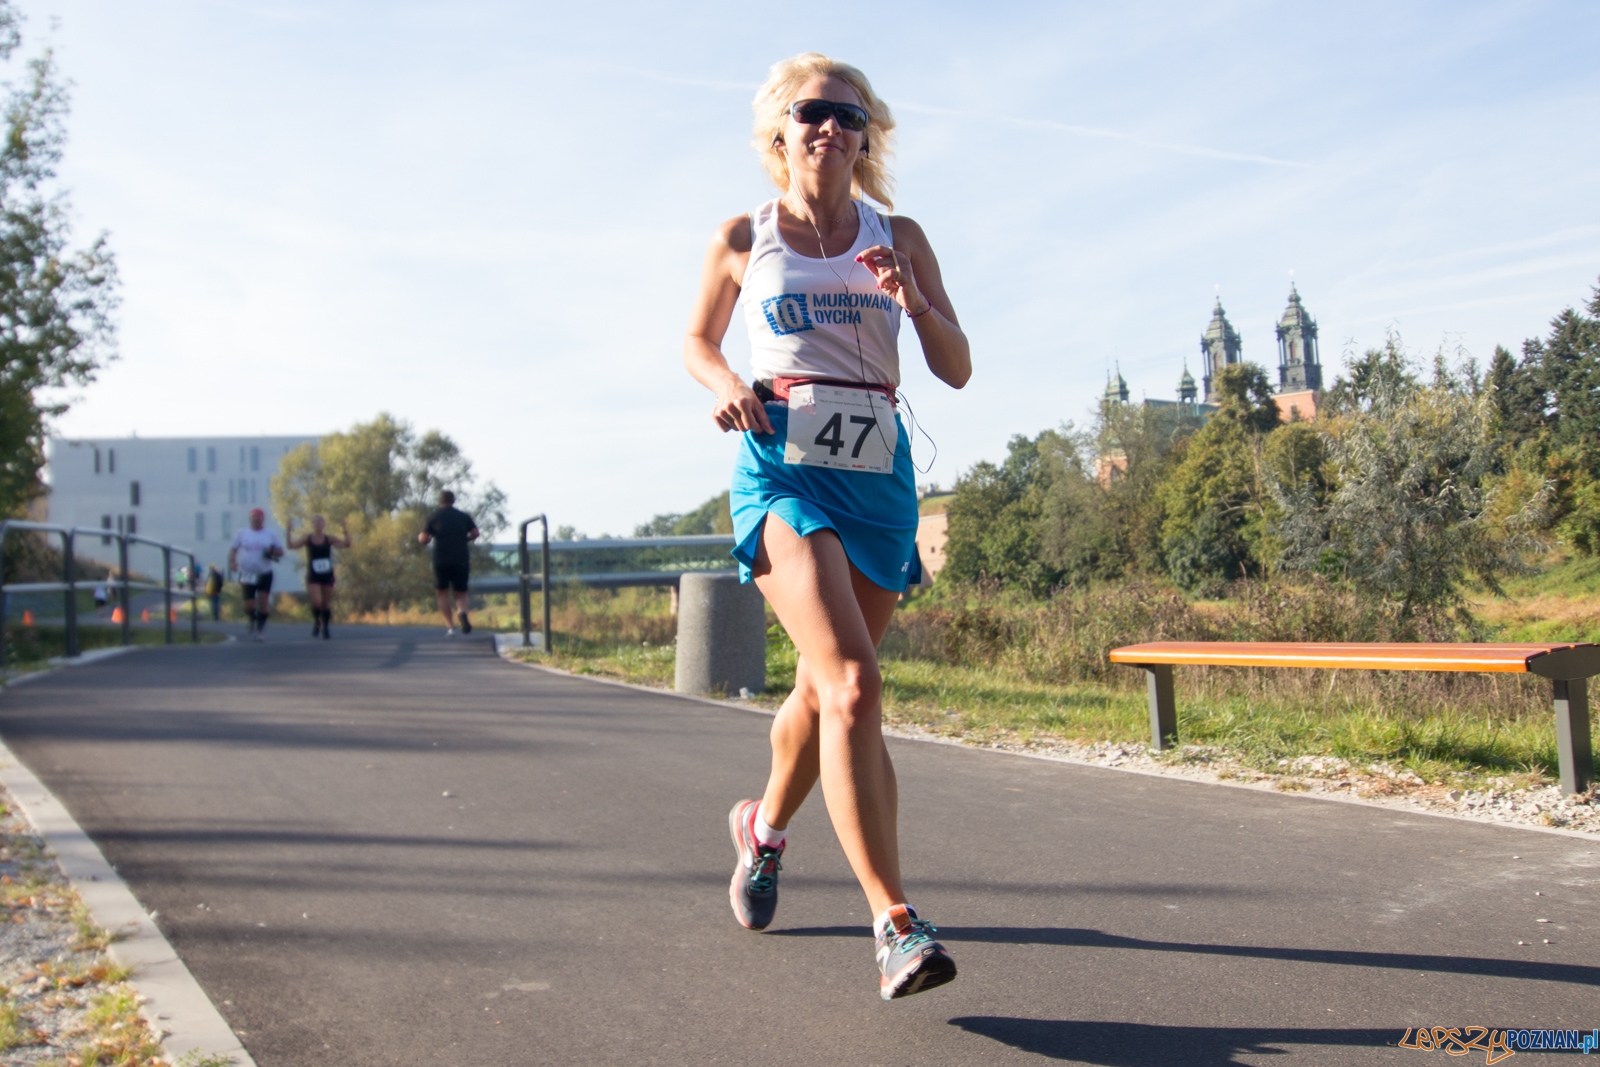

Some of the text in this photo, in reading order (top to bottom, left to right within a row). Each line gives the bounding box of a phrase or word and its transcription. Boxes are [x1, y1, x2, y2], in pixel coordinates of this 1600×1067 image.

[763, 296, 806, 335] 10
[812, 293, 892, 312] MUROWANA
[815, 310, 861, 325] DYCHA
[814, 412, 877, 458] 47
